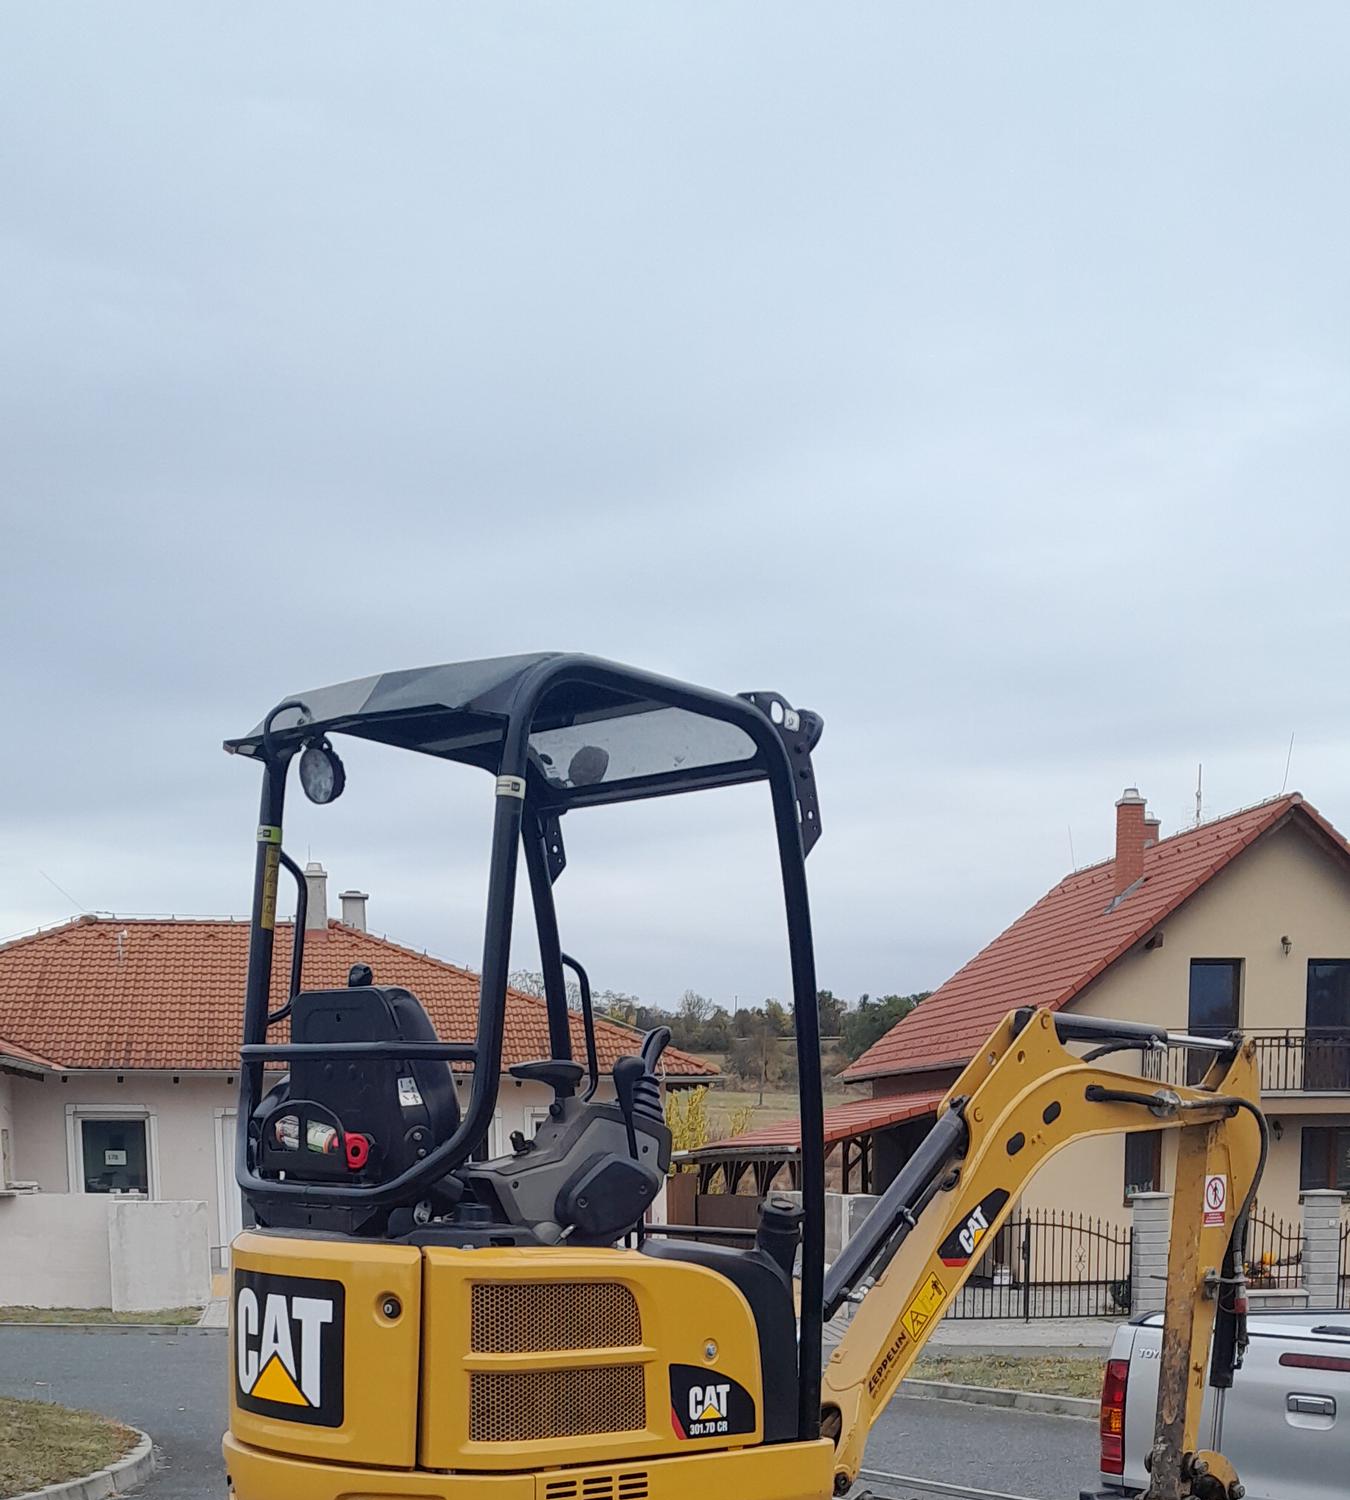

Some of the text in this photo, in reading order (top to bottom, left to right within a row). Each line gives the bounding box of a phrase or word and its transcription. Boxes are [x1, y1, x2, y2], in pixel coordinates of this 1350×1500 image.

[959, 1205, 989, 1254] CAT
[237, 1287, 333, 1408] CAT
[868, 1331, 907, 1395] ZEPPELIN
[1139, 1348, 1161, 1359] TOY
[689, 1384, 730, 1420] CAT
[689, 1420, 728, 1435] 301.7D CR
